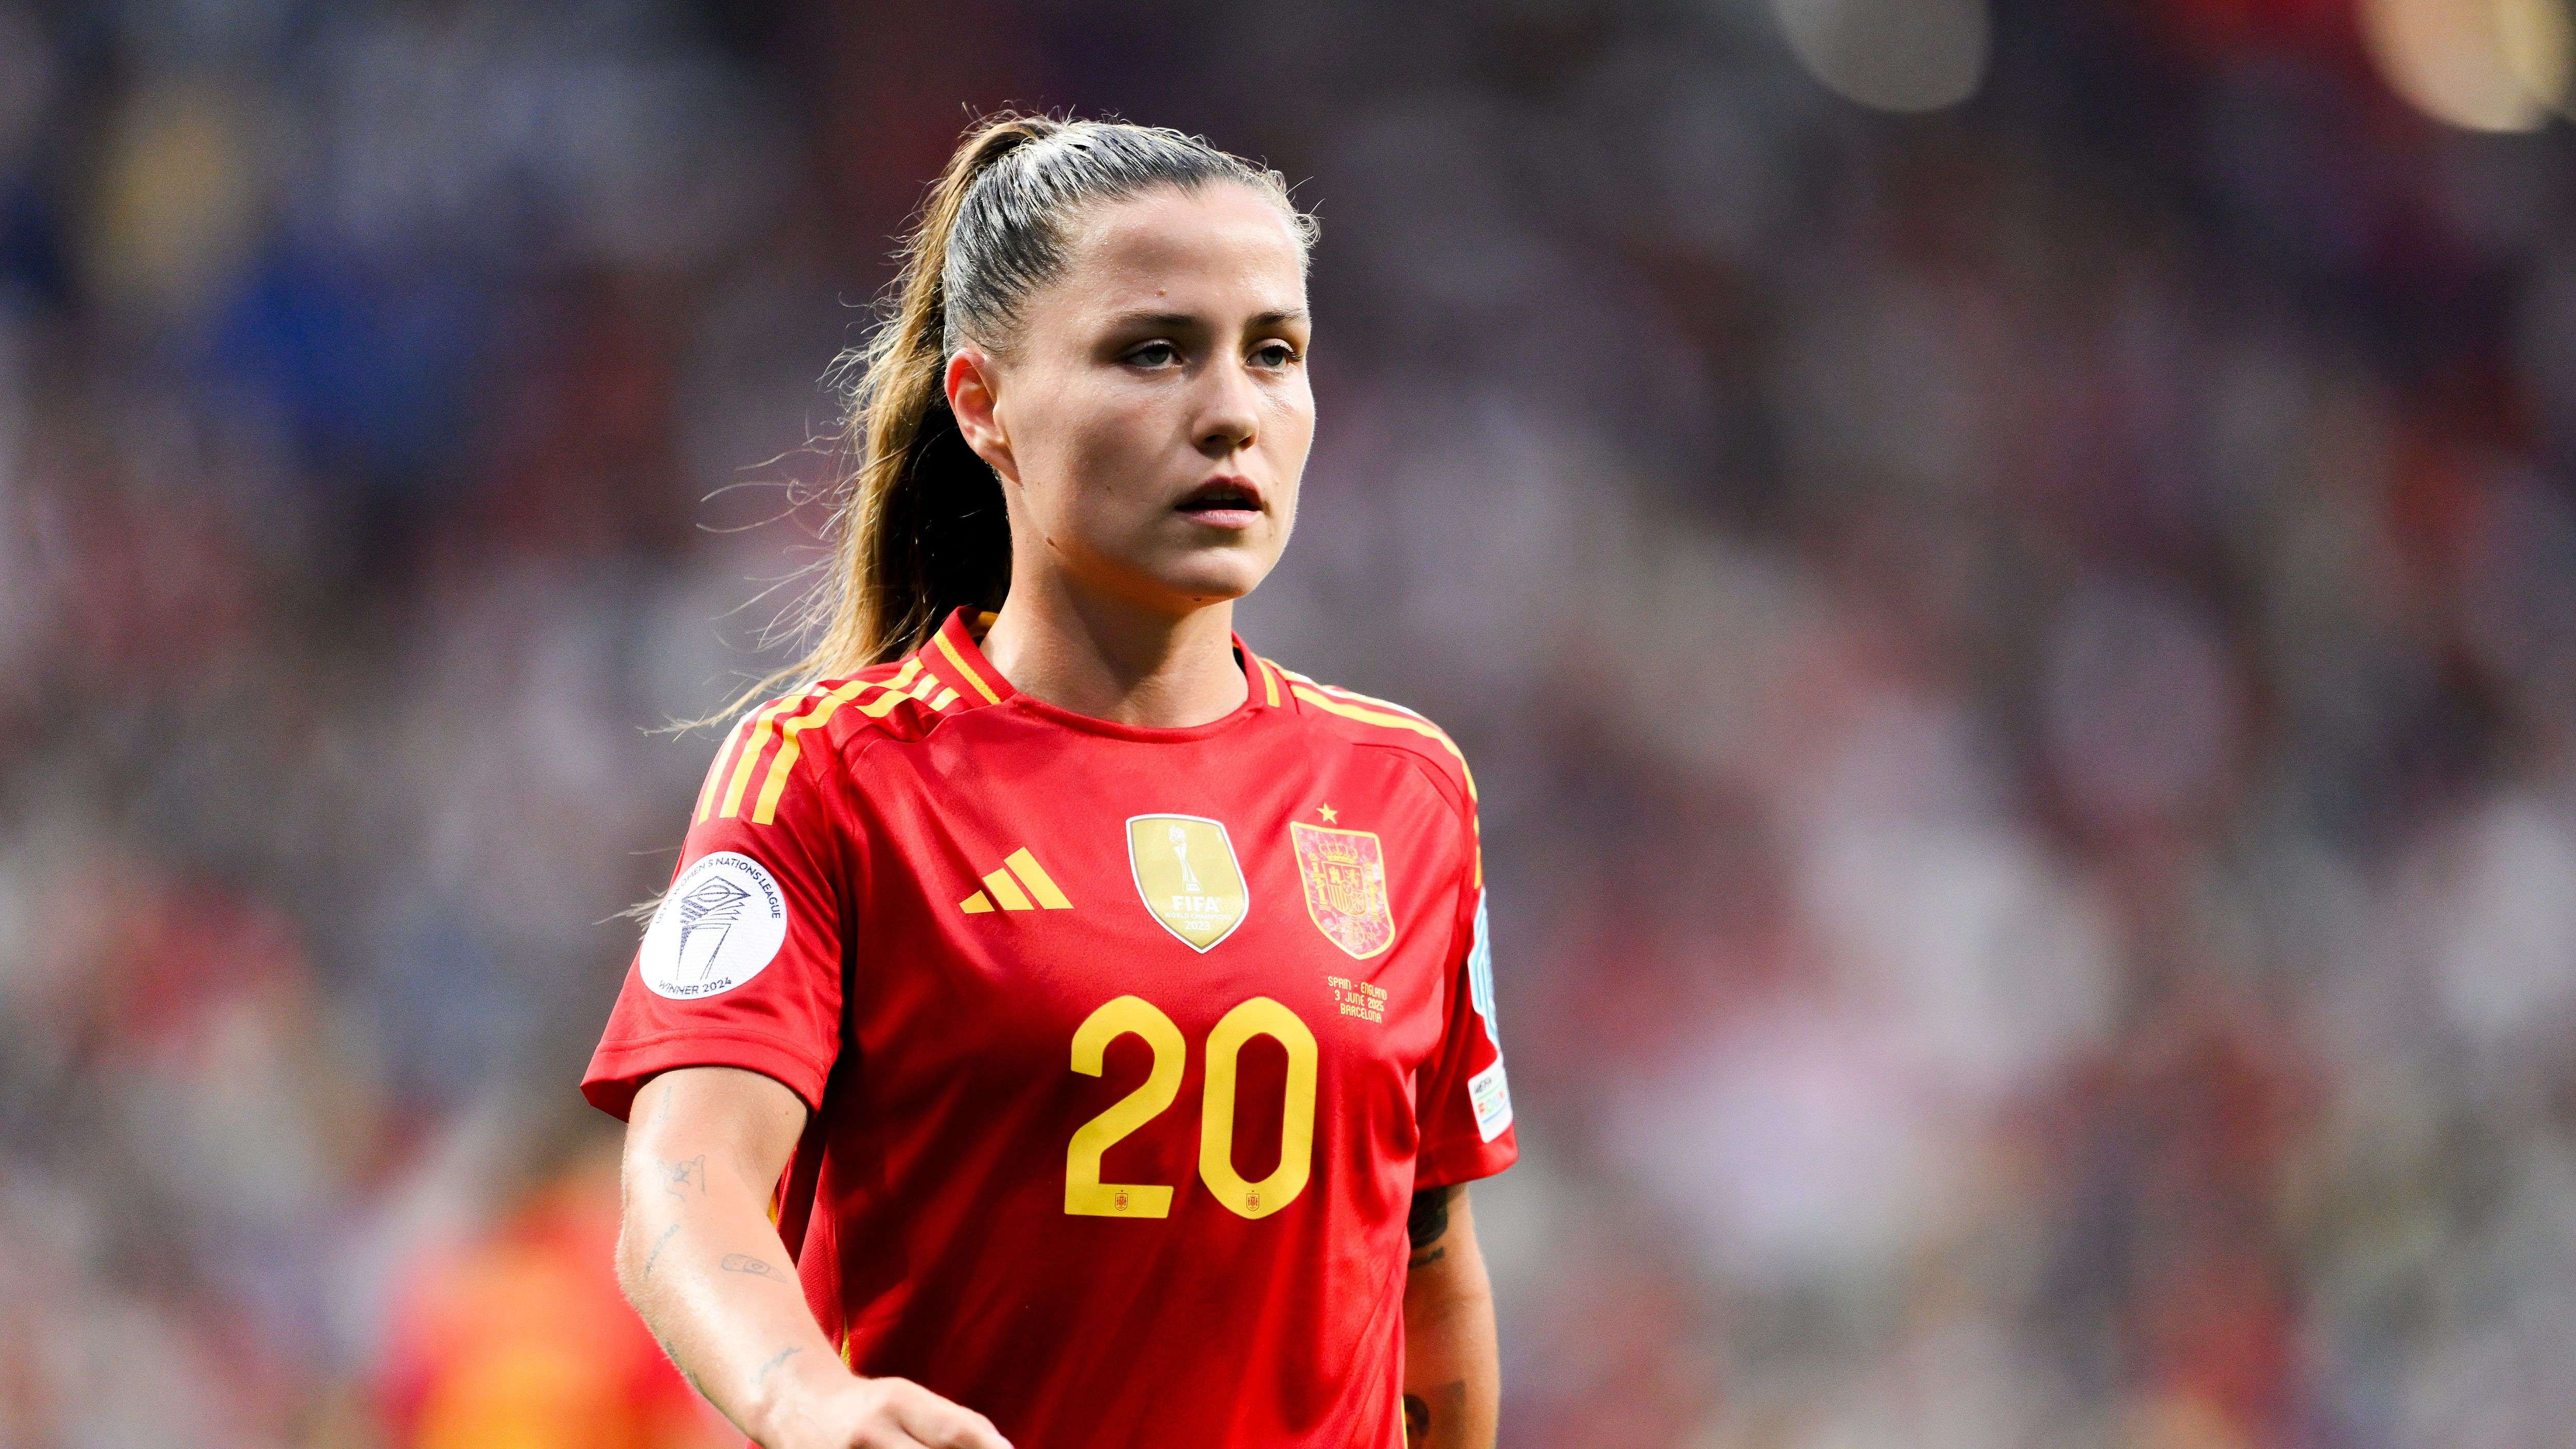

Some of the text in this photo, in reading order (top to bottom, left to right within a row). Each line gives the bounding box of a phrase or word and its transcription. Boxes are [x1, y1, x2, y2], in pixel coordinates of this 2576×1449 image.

[716, 858, 762, 880] NATIONS
[758, 878, 781, 919] LEAGUE
[1171, 895, 1220, 913] FIFA
[659, 977, 732, 995] WINNER 2024
[1328, 976, 1351, 990] SPAIN
[1361, 982, 1387, 1001] ENGLAND
[1334, 989, 1384, 1012] 3 JUNE 2025
[1340, 1003, 1382, 1024] BARCELONA
[1064, 994, 1318, 1220] 20
